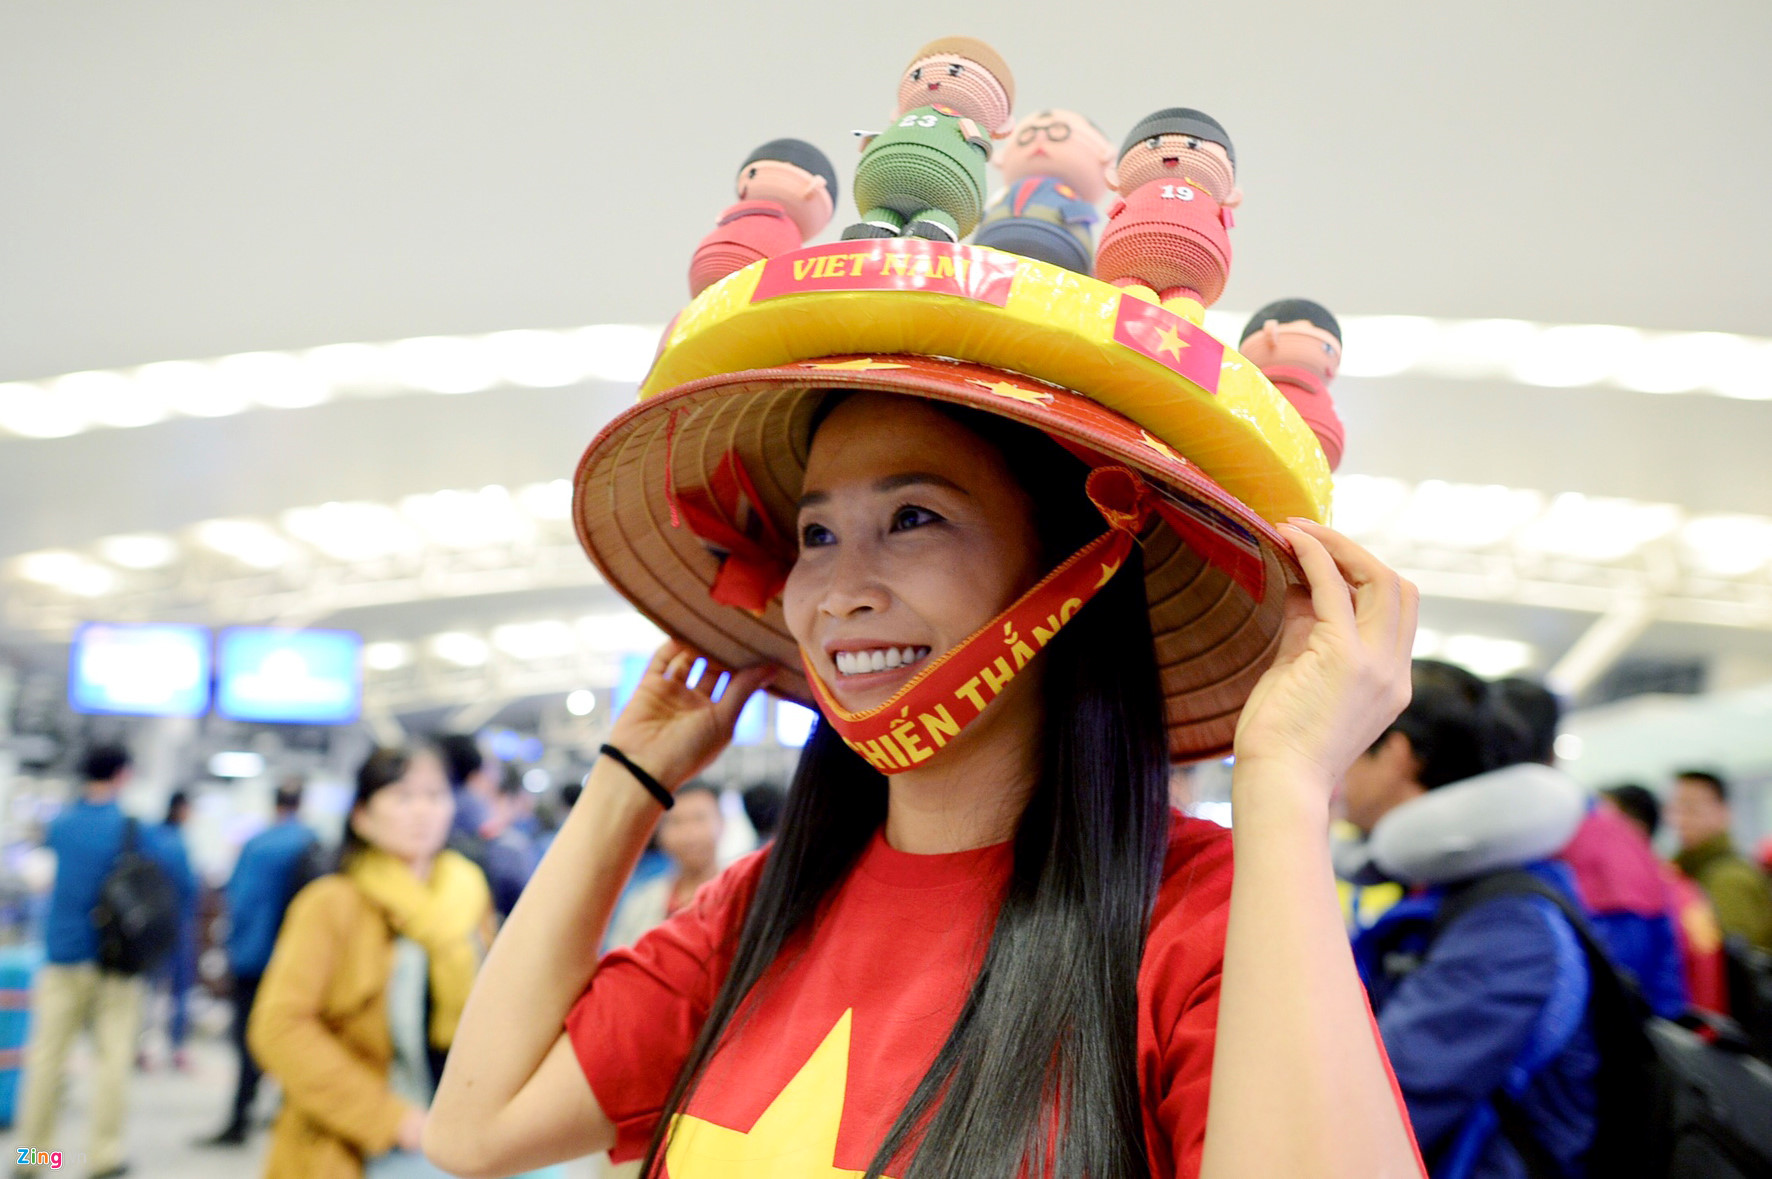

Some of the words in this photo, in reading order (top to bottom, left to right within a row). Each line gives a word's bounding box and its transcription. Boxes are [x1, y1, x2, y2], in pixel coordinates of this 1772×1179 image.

[898, 114, 938, 128] 23
[1160, 184, 1195, 202] 19
[792, 252, 869, 281] VIET
[880, 253, 970, 280] NAM
